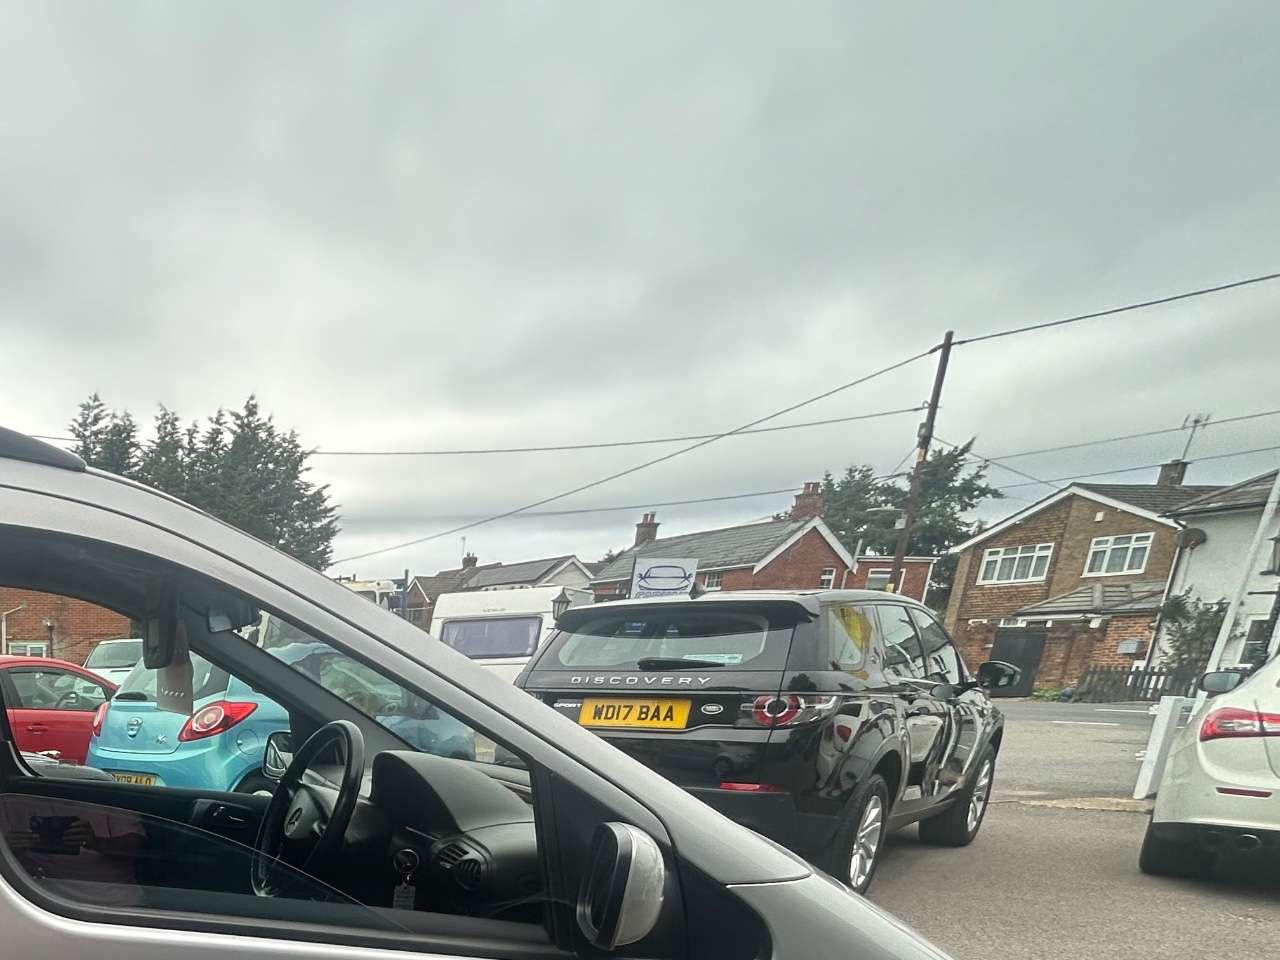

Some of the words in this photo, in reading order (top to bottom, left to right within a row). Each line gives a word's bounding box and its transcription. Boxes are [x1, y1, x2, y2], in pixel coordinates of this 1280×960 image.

[571, 676, 711, 685] DISCOVERY
[592, 704, 632, 721] WD17
[637, 704, 674, 721] BAA
